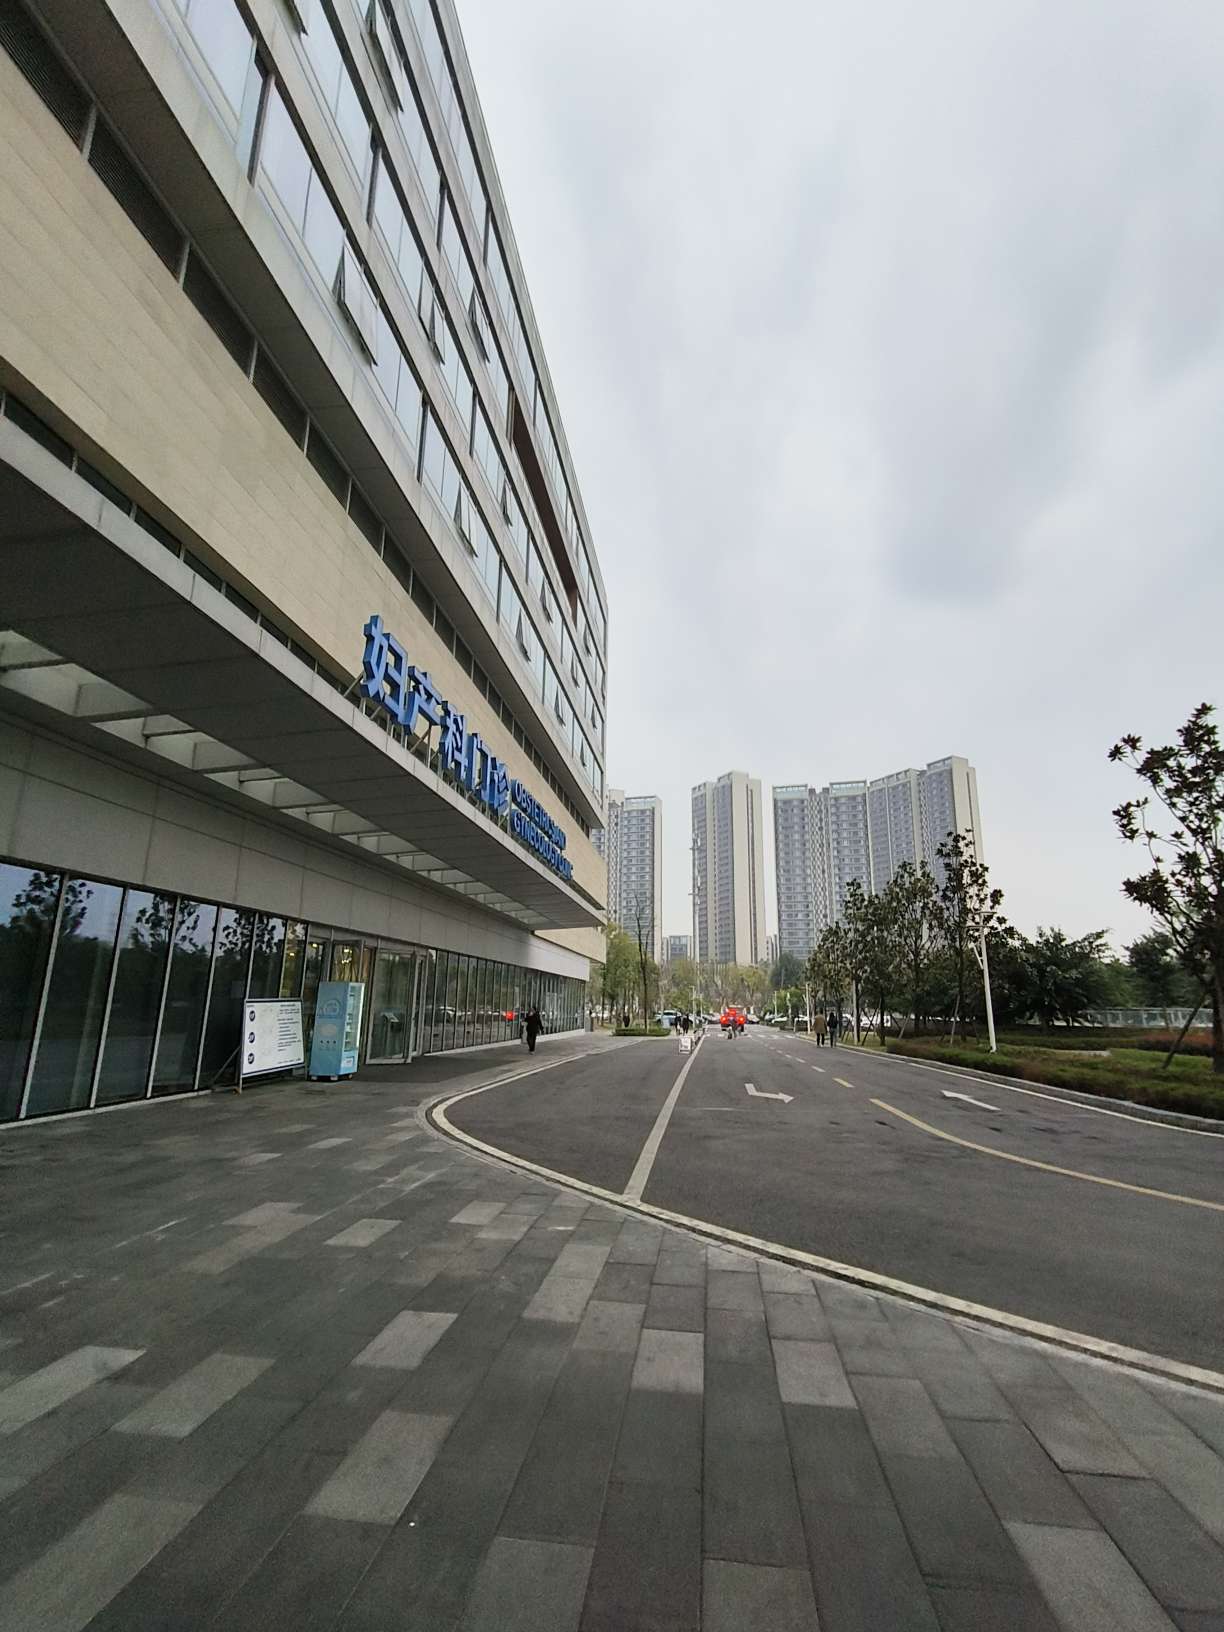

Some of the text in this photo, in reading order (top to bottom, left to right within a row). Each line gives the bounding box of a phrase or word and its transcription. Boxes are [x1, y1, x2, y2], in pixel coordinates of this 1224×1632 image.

[360, 614, 511, 815] 妇产科门诊
